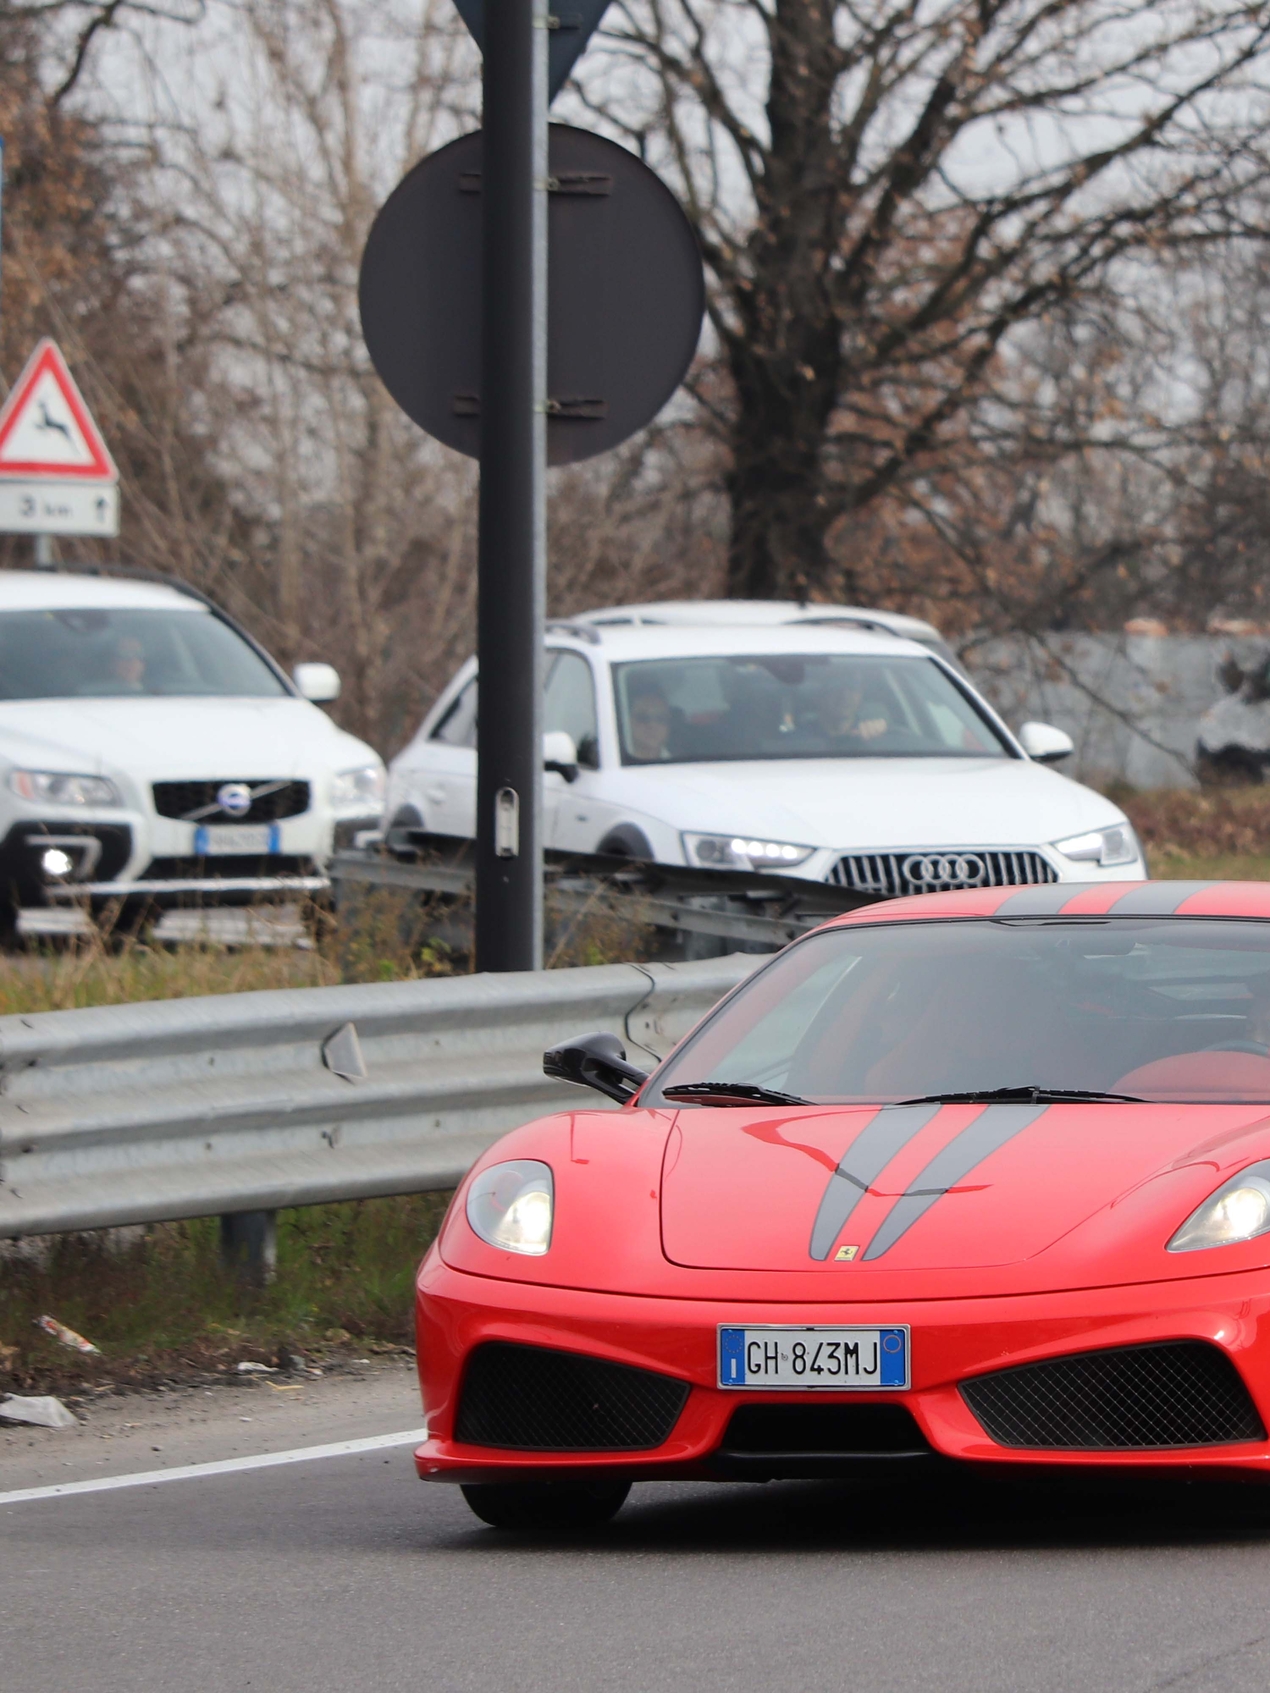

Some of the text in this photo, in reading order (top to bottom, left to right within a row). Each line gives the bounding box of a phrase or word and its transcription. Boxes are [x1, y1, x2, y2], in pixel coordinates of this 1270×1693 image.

[20, 494, 36, 518] 3
[747, 1341, 878, 1375] GH 843MJ
